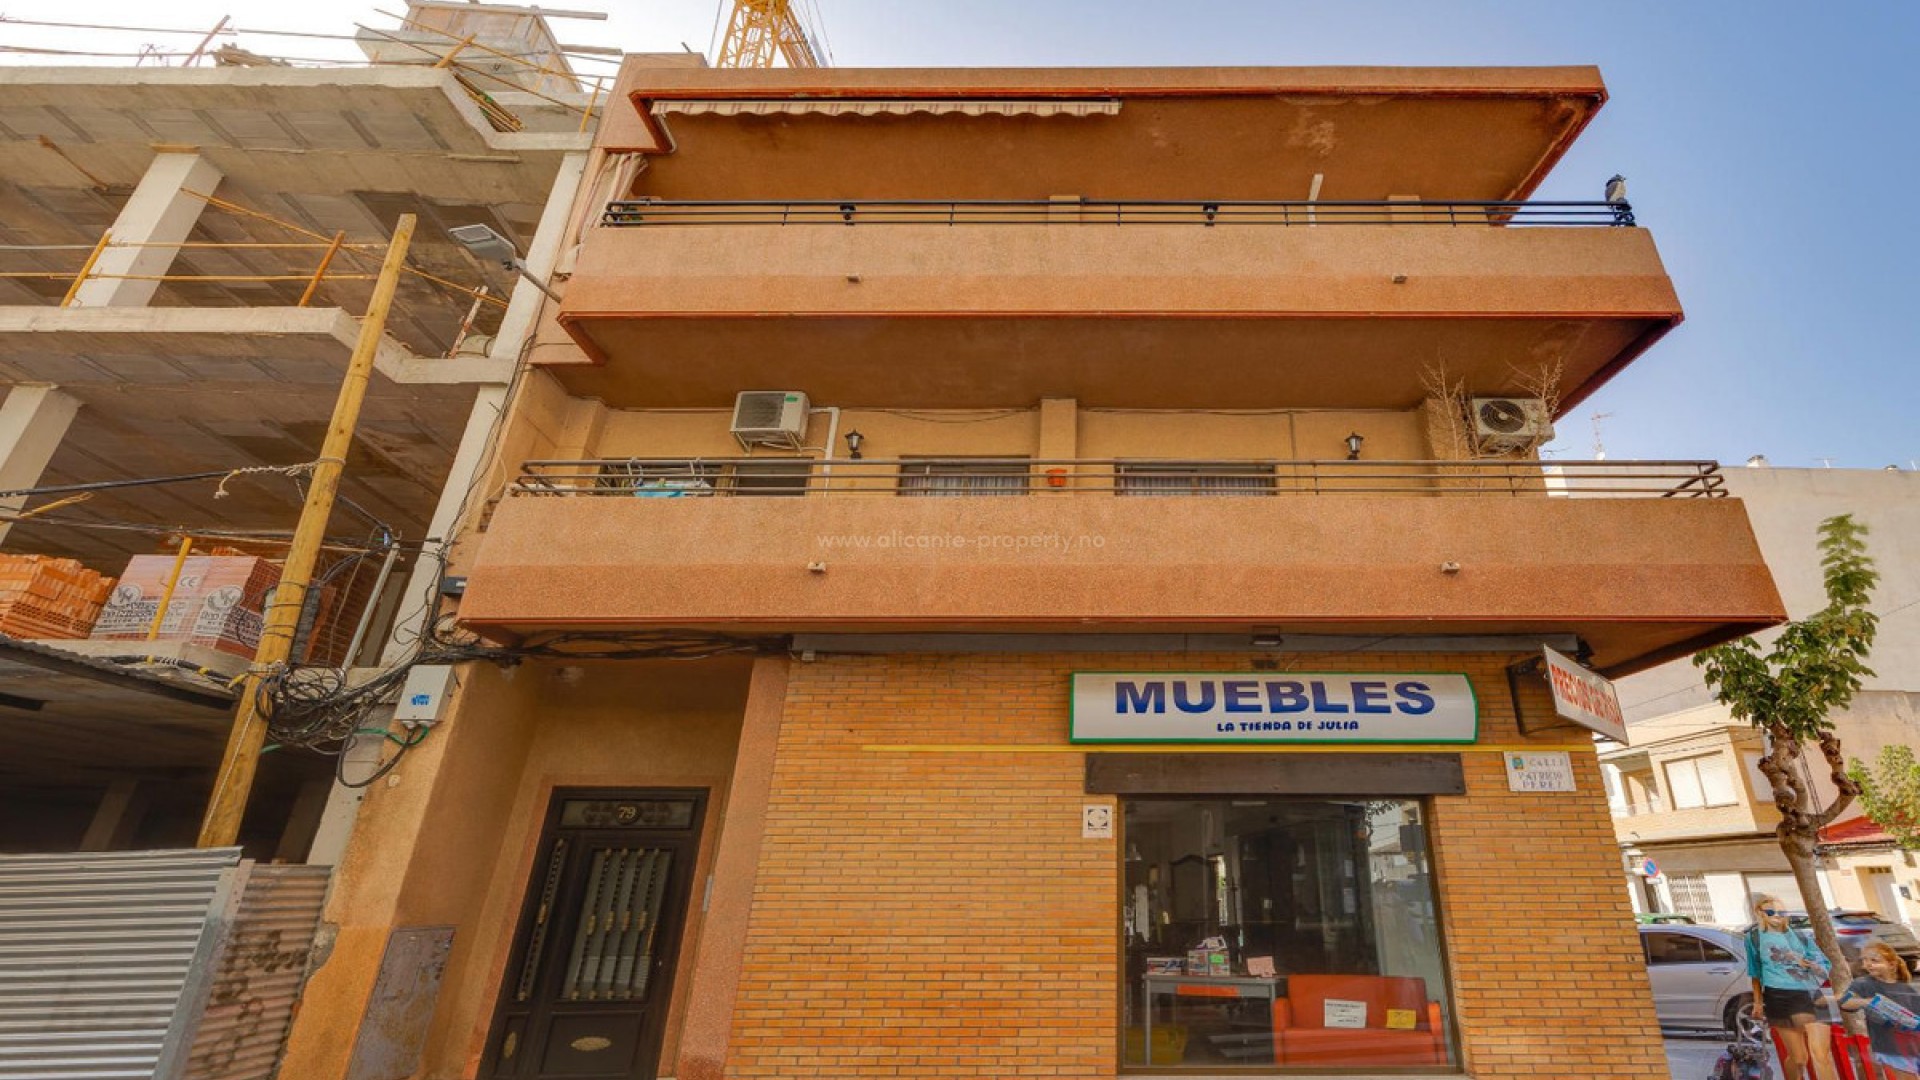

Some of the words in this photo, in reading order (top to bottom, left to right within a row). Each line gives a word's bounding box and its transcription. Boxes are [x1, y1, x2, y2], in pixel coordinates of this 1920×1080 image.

[1115, 681, 1435, 715] MUEBLES
[1217, 722, 1235, 732] LA
[1239, 721, 1292, 731] TIENDA
[1297, 720, 1313, 730] DE
[1317, 720, 1359, 730] JULIA
[618, 805, 636, 820] 79
